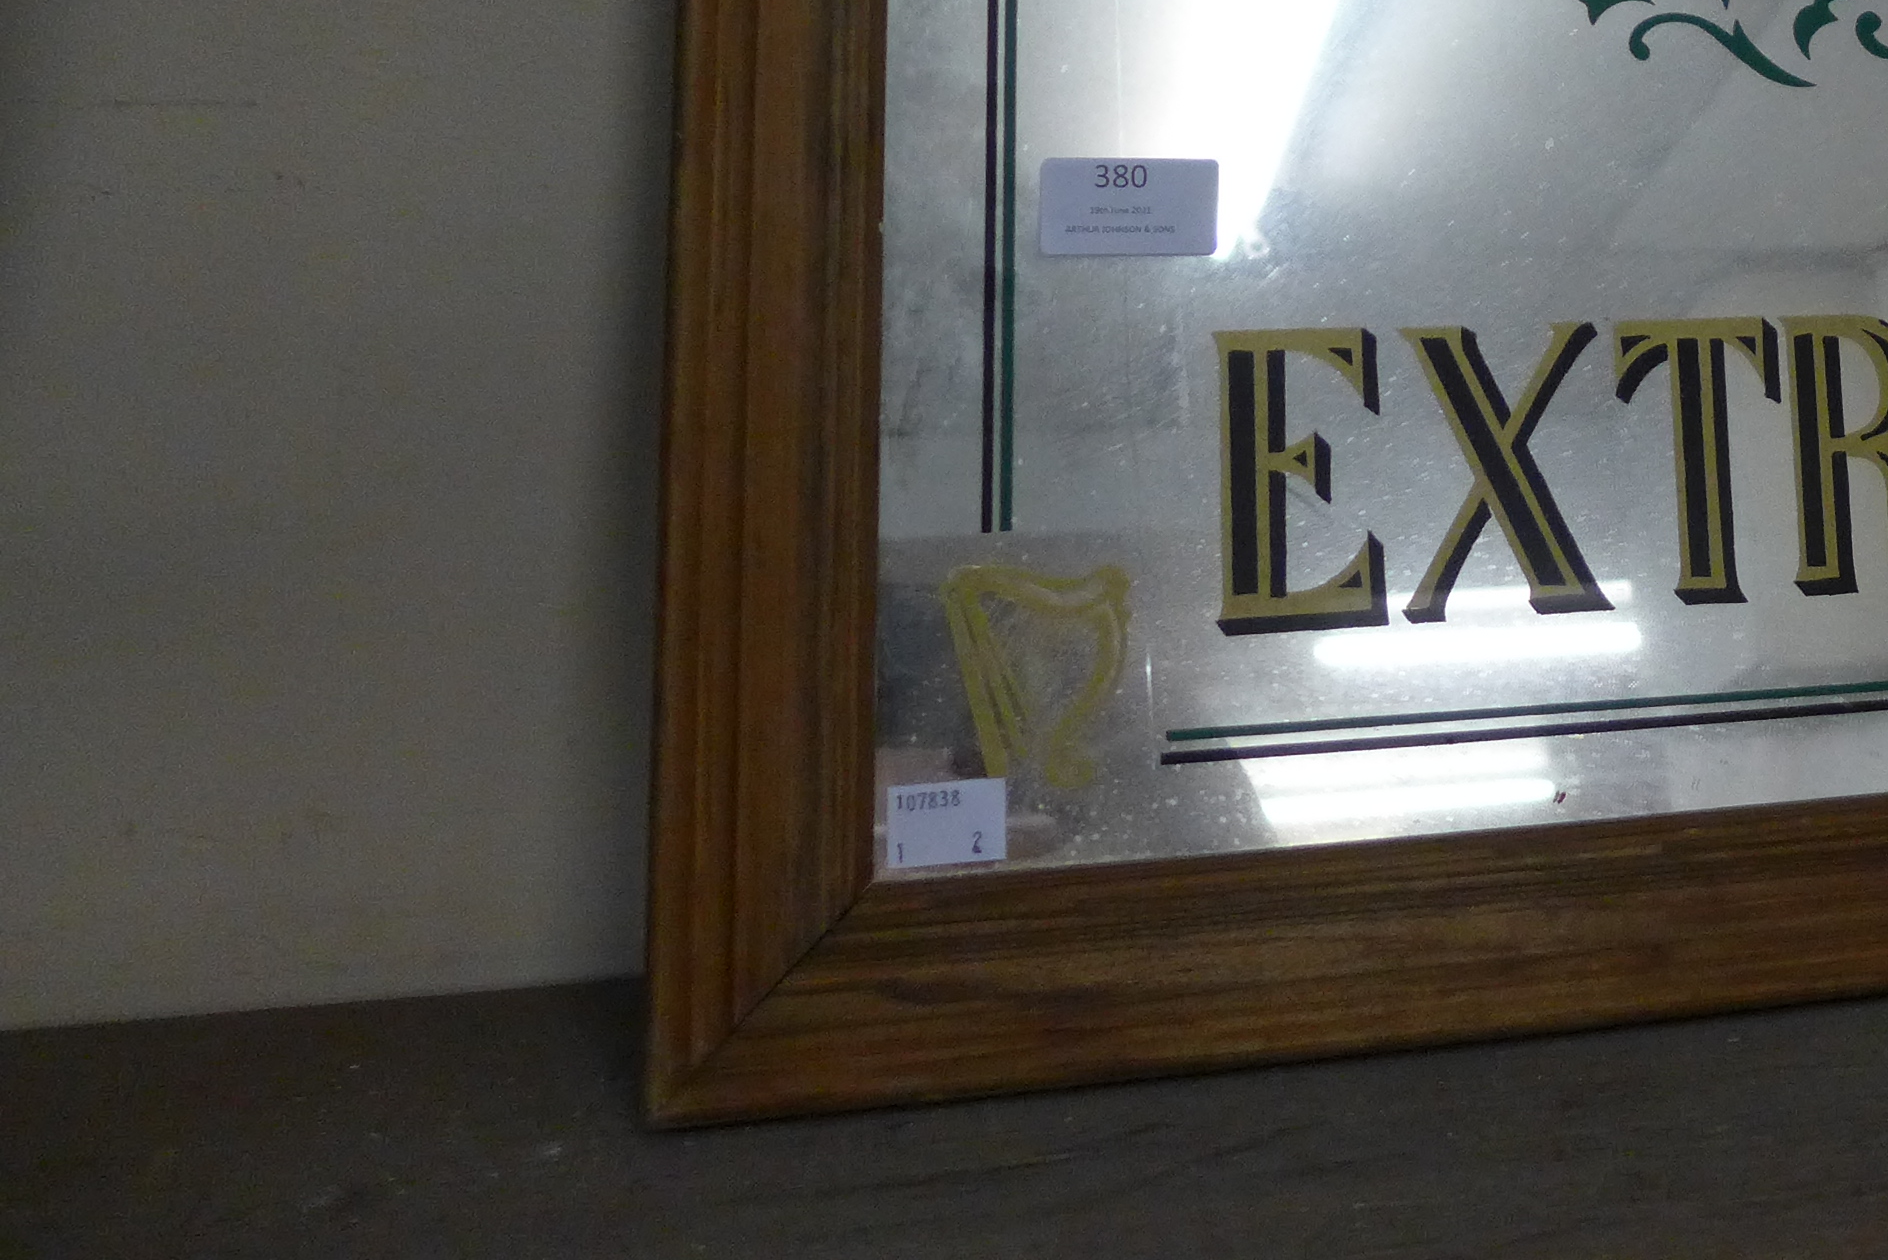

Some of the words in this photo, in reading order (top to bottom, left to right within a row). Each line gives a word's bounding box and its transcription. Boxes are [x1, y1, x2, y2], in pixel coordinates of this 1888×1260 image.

[1094, 164, 1148, 188] 380
[896, 790, 961, 811] 107838
[896, 843, 903, 863] 1
[972, 831, 982, 854] 2
